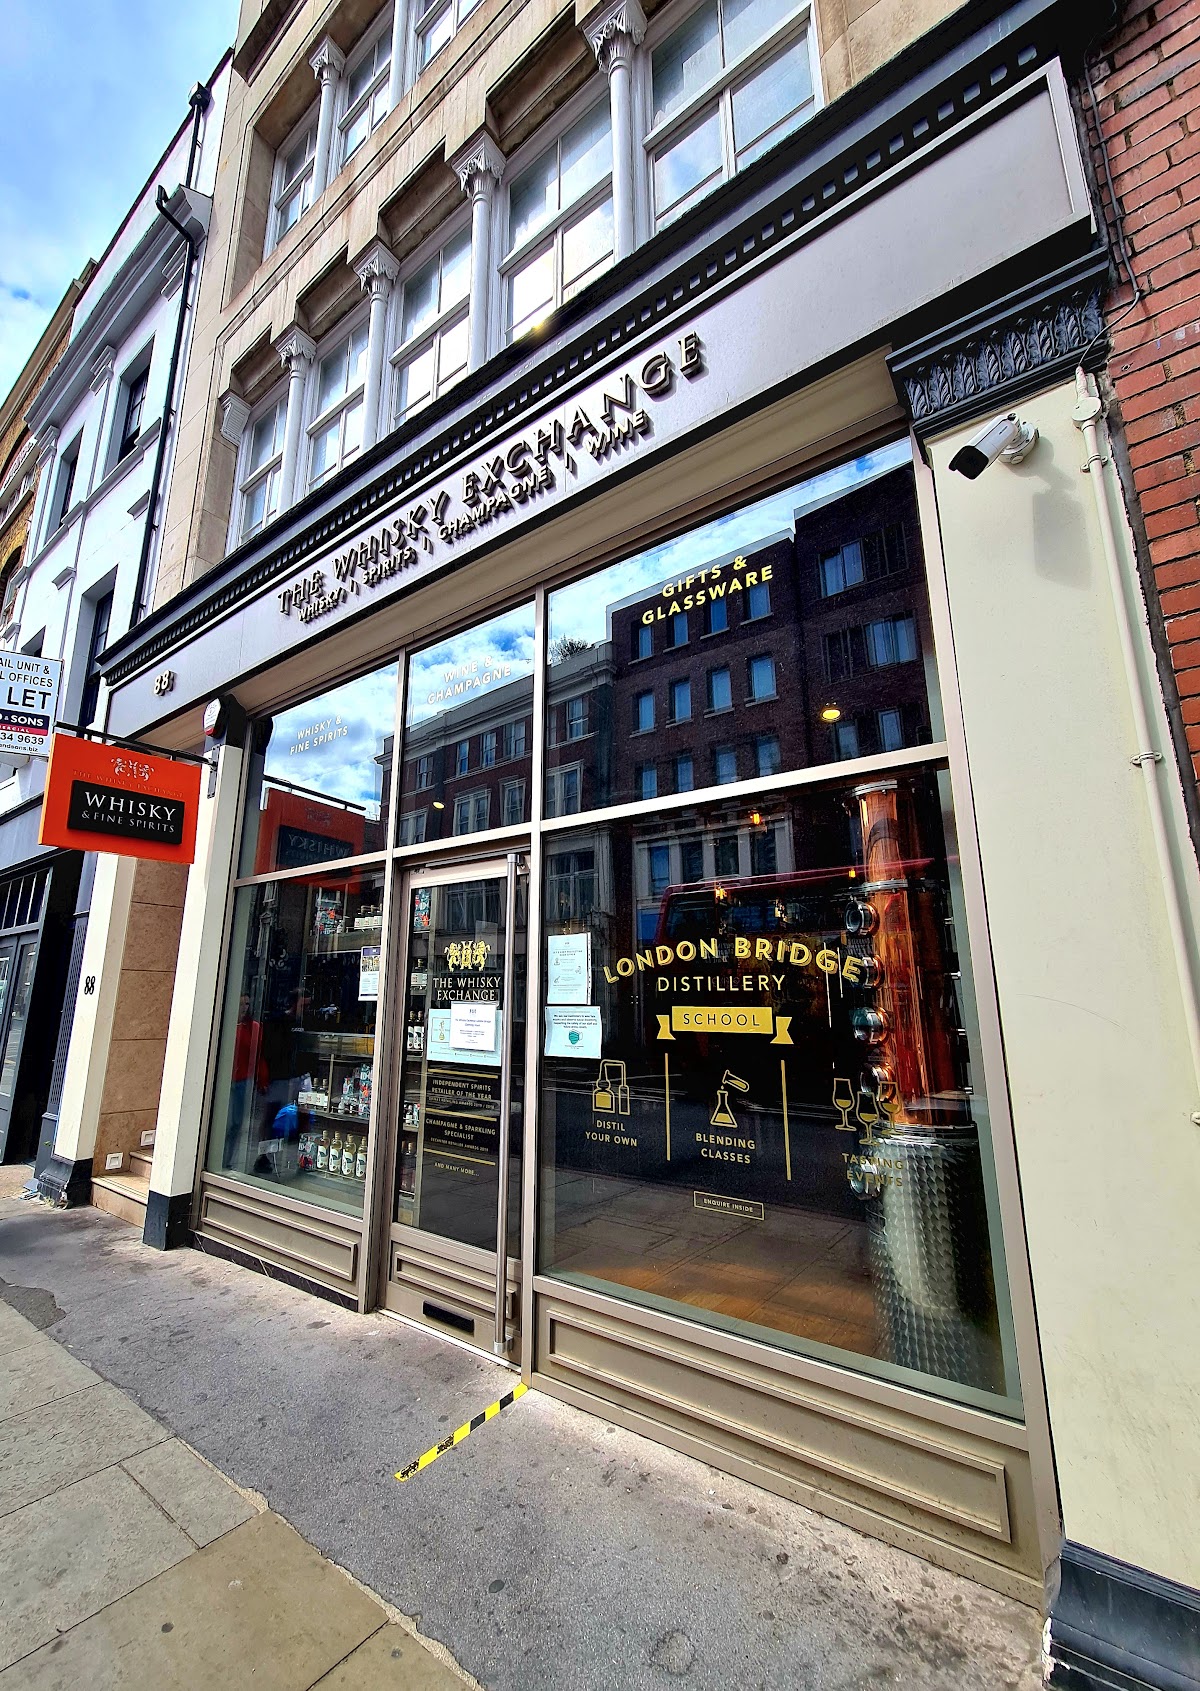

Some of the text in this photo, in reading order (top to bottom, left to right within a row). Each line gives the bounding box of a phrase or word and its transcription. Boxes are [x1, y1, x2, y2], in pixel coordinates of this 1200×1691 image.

[278, 331, 704, 616] THE WHISKY EXCHANGE
[297, 409, 652, 623] WHISKY SPIRITS CHAMPAGNE WINE
[662, 555, 747, 598] GIFTS &
[642, 564, 774, 625] GLASSWARE
[17, 660, 41, 673] UNIT
[43, 665, 50, 675] &
[443, 655, 494, 683] WINE &
[9, 672, 53, 688] OFFICES
[154, 669, 174, 696] 88
[427, 664, 512, 705] CHAMPAGNE
[7, 686, 52, 710] LET
[0, 725, 29, 733] ERCIAL
[10, 715, 44, 727] SONS
[296, 715, 342, 740] WHISKY &
[0, 732, 44, 745] 34 9639
[289, 725, 349, 756] FINE SPIRITS
[84, 791, 176, 822] WHISKY
[81, 810, 175, 833] & FINE SPIRITS
[603, 938, 718, 984] LONDON
[734, 937, 866, 983] BRIDGE
[84, 976, 95, 995] 88
[432, 976, 501, 988] THE WHISKY
[658, 974, 786, 992] DISTILLERY
[437, 990, 495, 1001] EXCHANGE
[683, 1013, 761, 1027] SCHOOL
[431, 1087, 455, 1096] RETAILER
[465, 1091, 476, 1099] THE
[477, 1092, 492, 1100] YEAR
[432, 1079, 491, 1092] INDEPENDENT SPIRITS
[425, 1118, 458, 1129] CHAMPAGNE
[465, 1124, 496, 1136] SPARKLING
[596, 1119, 626, 1132] DISTIL
[444, 1130, 474, 1140] SPECIALIST
[585, 1131, 638, 1147] YOUR OWN
[695, 1133, 756, 1150] BLENDING
[701, 1148, 752, 1164] CLASSES
[841, 1152, 904, 1171] TASTING
[445, 1164, 460, 1172] MANY
[846, 1169, 903, 1187] EVENTS
[703, 1198, 754, 1213] ENQUIRE INSIDE
